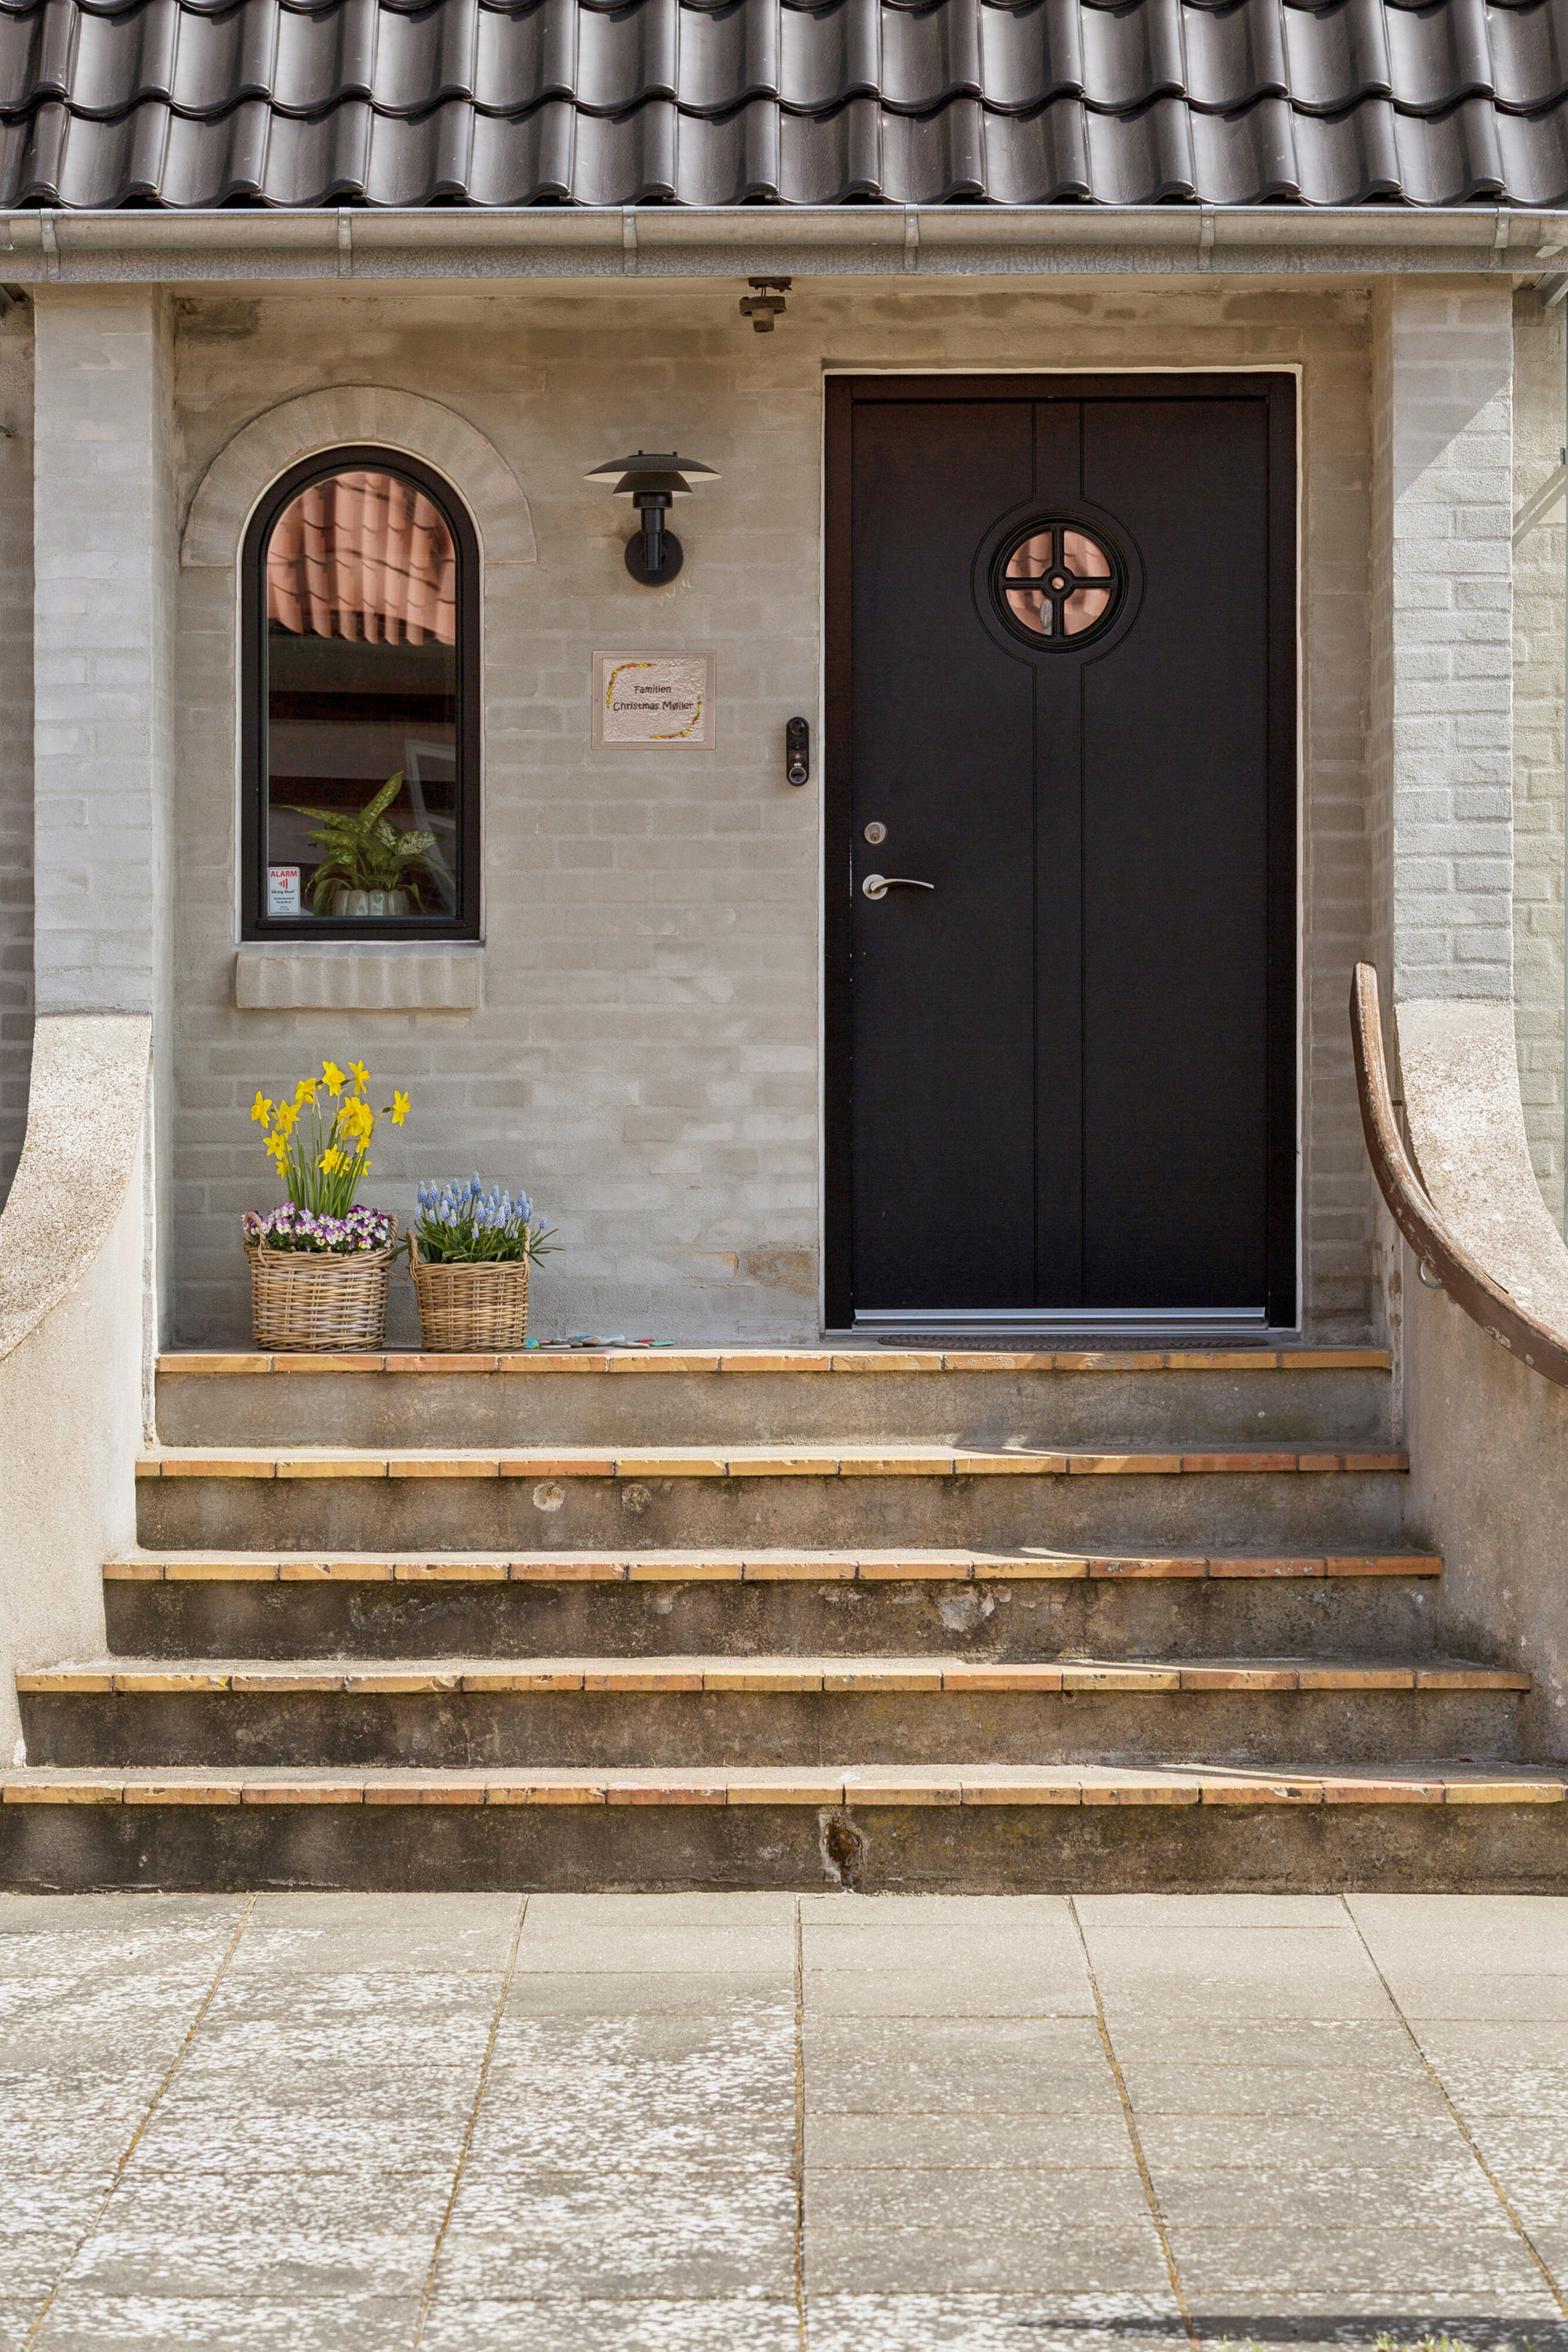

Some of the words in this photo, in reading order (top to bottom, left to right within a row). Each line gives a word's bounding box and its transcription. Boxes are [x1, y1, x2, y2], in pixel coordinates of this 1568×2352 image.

[633, 685, 672, 694] Familien
[613, 701, 659, 711] Christmas
[662, 700, 694, 710] Møller
